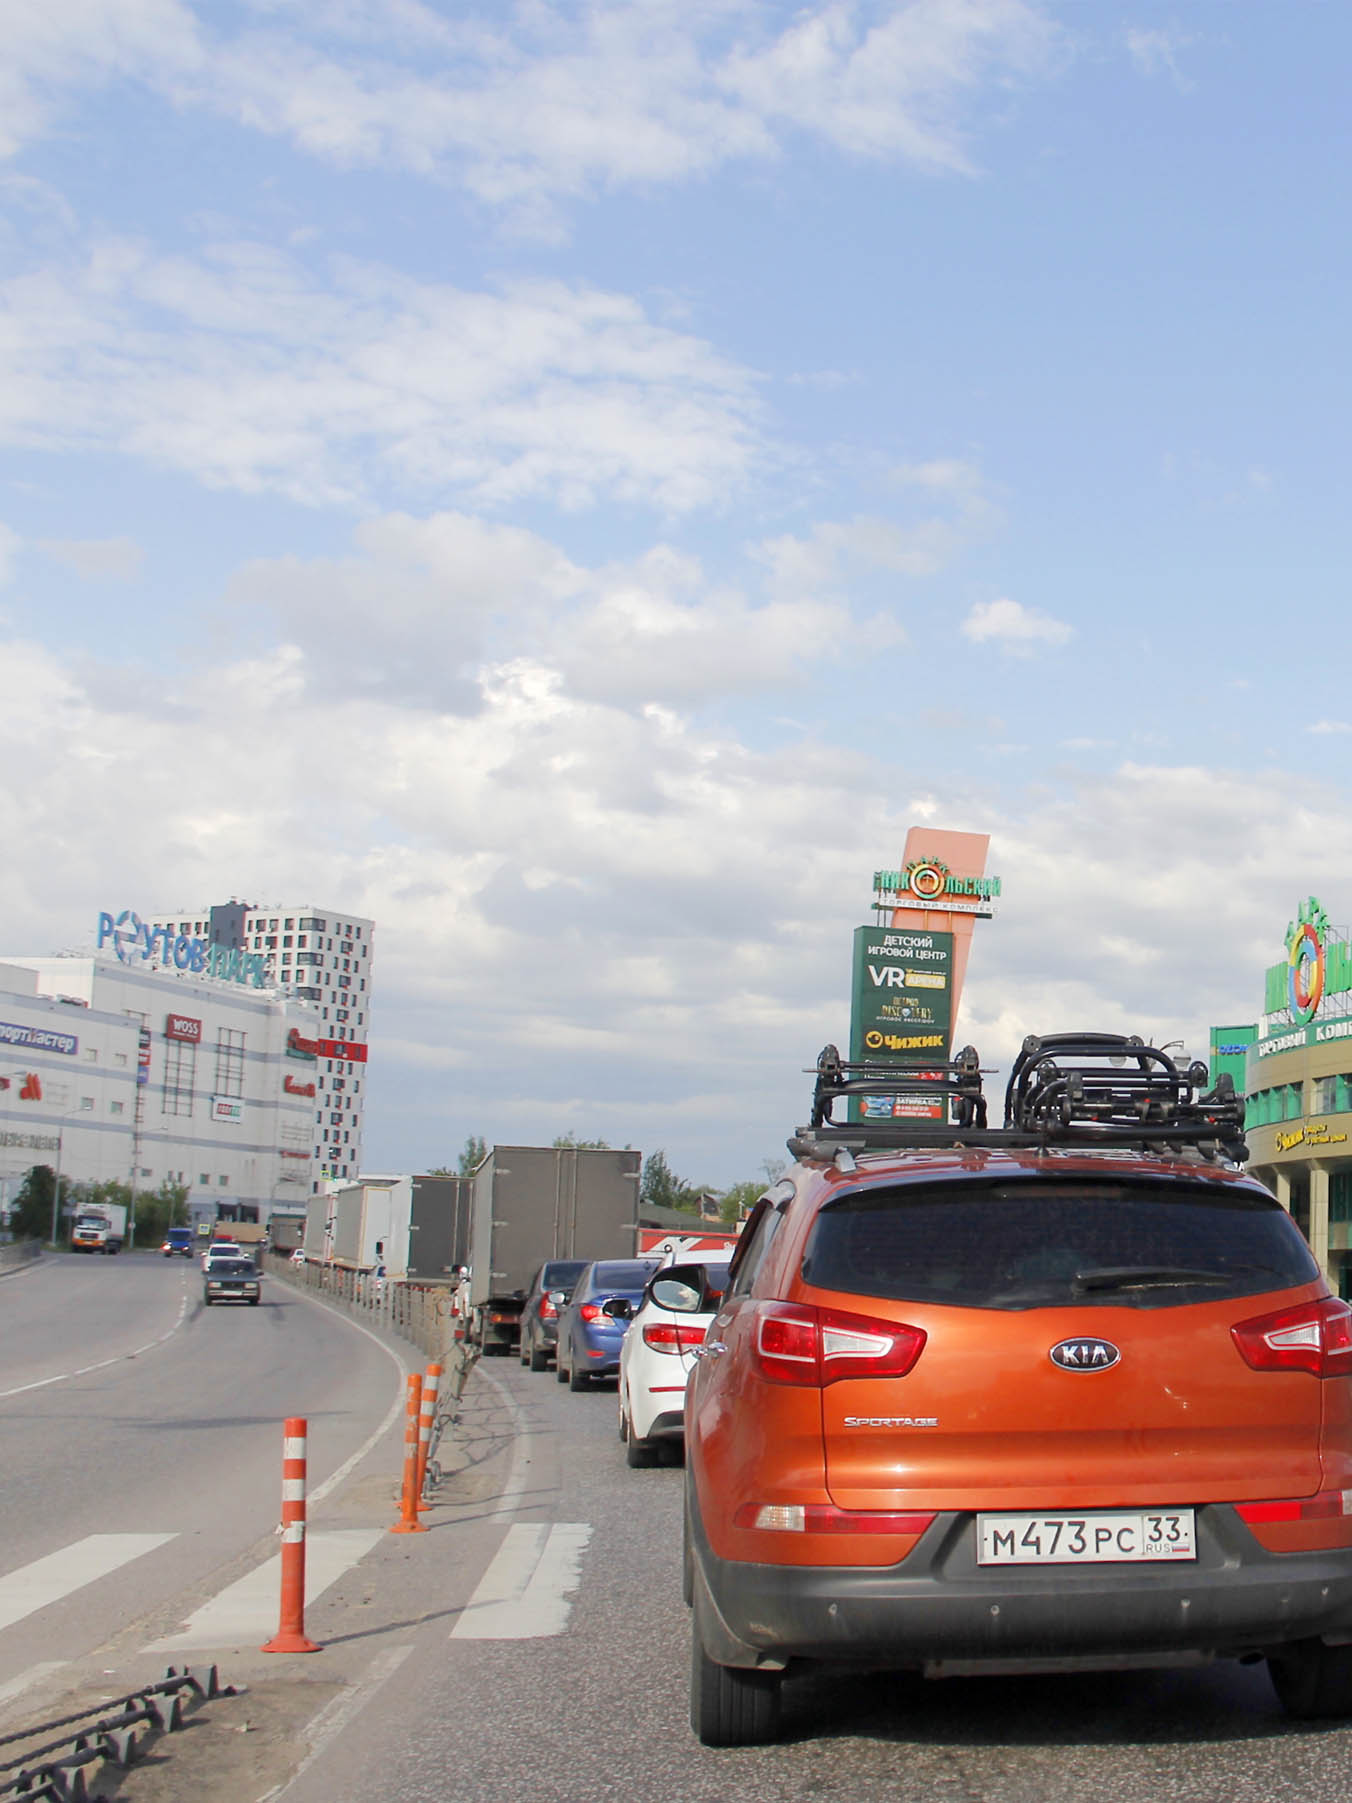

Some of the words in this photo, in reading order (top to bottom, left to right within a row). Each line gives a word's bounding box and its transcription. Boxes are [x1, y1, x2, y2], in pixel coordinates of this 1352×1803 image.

[905, 855, 949, 874] ПАРК
[942, 903, 1000, 913] КОМПЛЕКС
[883, 935, 933, 948] ДЕТСКИЙ
[867, 945, 913, 958] ИГРОВОЙ
[916, 950, 947, 960] ЦЕНТР
[868, 965, 905, 988] VR
[173, 1019, 199, 1034] WOSS
[1061, 1345, 1109, 1364] KIA
[843, 1416, 938, 1428] SPORTAGE
[992, 1521, 1135, 1556] М473РС
[1147, 1516, 1181, 1542] 33
[1146, 1543, 1171, 1553] RUS
